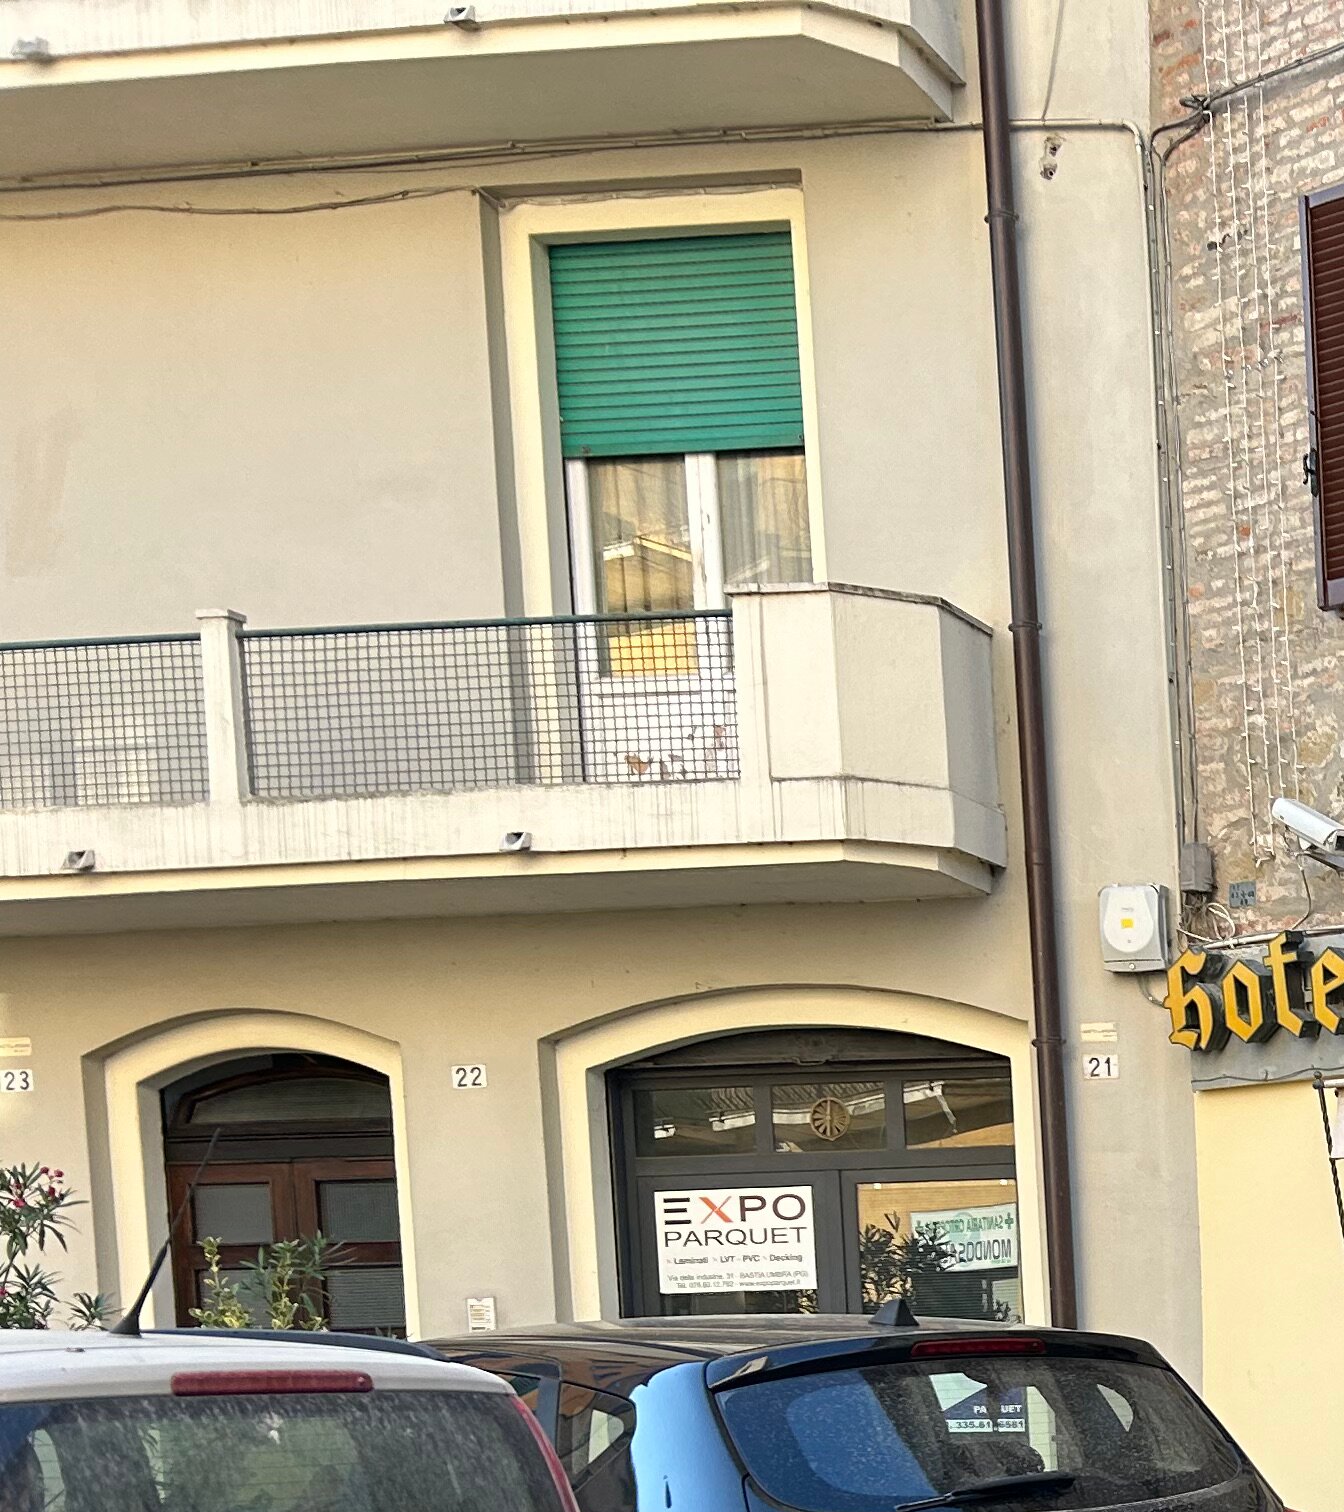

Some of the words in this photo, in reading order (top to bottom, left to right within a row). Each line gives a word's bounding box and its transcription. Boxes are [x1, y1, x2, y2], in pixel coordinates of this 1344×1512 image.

[456, 1067, 482, 1087] 22
[1088, 1057, 1111, 1077] 21
[4, 1071, 30, 1090] 23
[663, 1193, 806, 1225] EXPO
[664, 1227, 807, 1247] PARQUET
